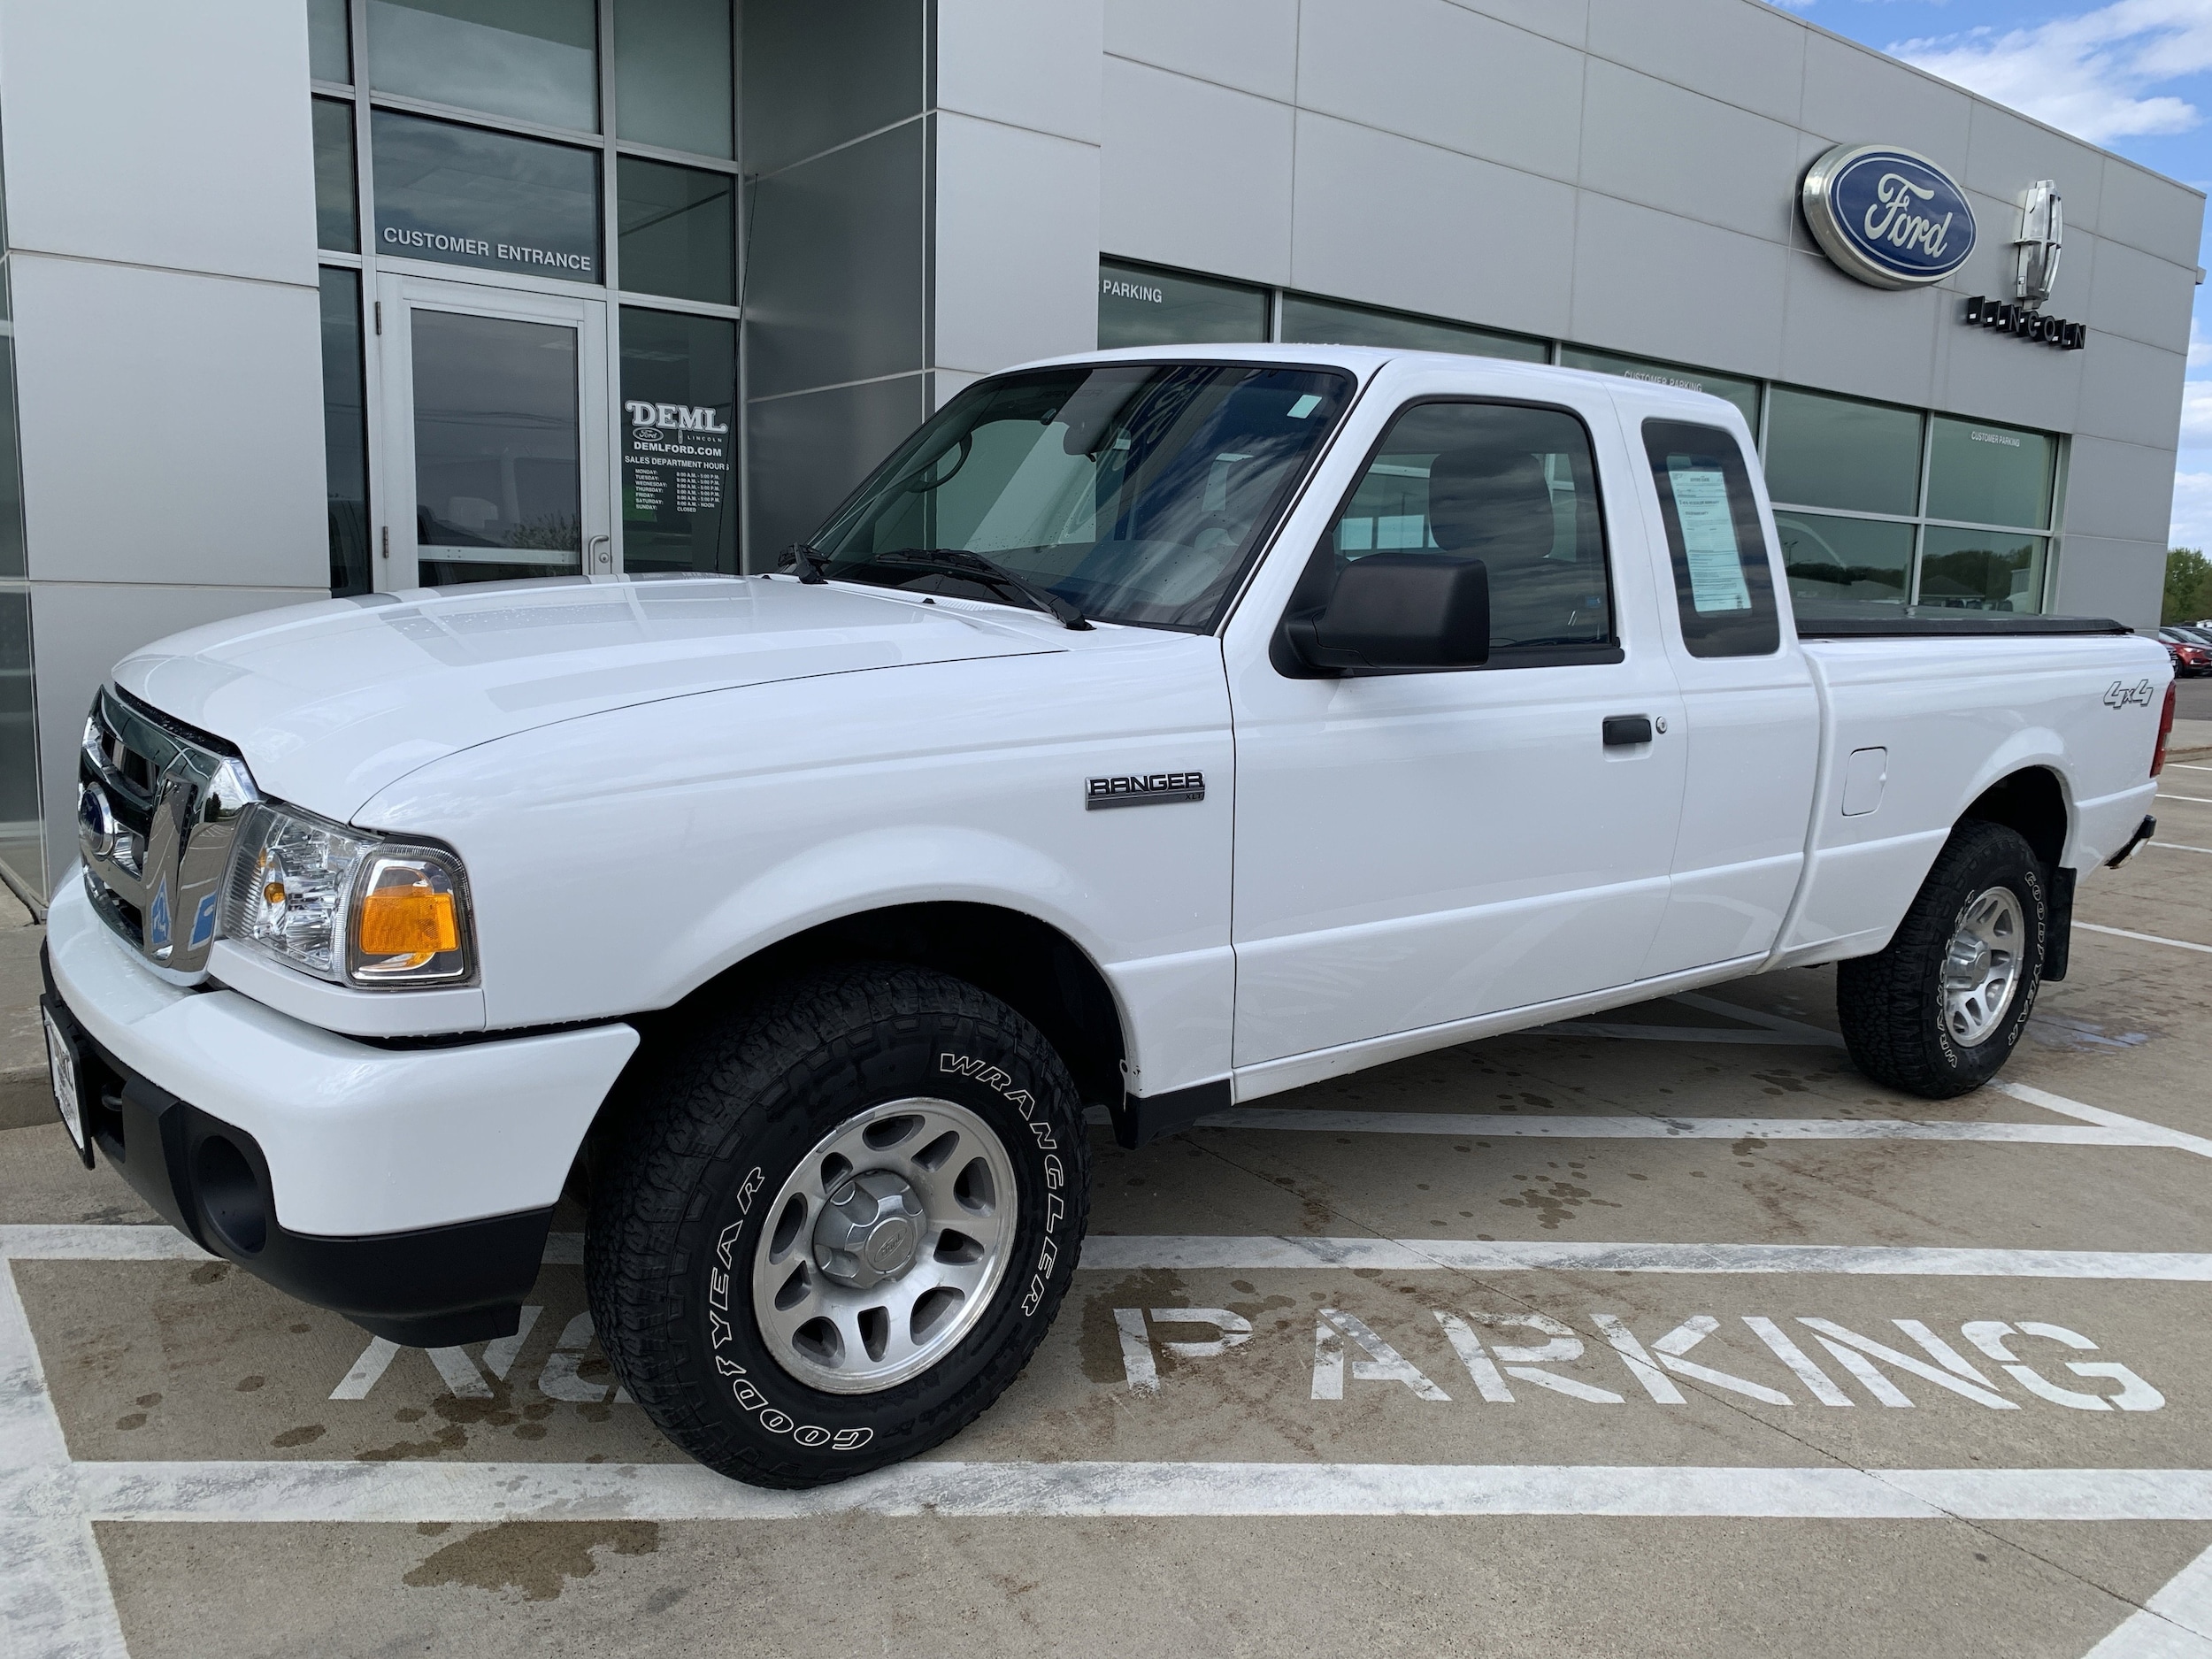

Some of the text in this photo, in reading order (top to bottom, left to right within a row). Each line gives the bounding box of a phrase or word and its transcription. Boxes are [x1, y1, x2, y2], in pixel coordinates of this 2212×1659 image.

[1864, 173, 1954, 258] Ford
[383, 227, 591, 271] CUSTOMER ENTRANCE
[1102, 280, 1162, 303] PARKING
[1966, 296, 2086, 349] LINCOLN
[1624, 371, 1702, 393] CUSTOMER PARKING
[625, 400, 728, 434] DEML
[638, 429, 657, 439] Ford
[1971, 431, 2021, 447] CUSTOMER PARKING
[624, 455, 730, 471] SALES DEPARTMENT HOURS
[634, 442, 722, 457] DEMLFORD.COM
[2103, 679, 2154, 710] 4x4
[1089, 772, 1205, 796] RANGER
[1185, 792, 1203, 801] XLT
[940, 1052, 1064, 1317] WRANGLER
[709, 1166, 874, 1450] GOODYEAR
[1113, 1308, 2165, 1412] PARKING
